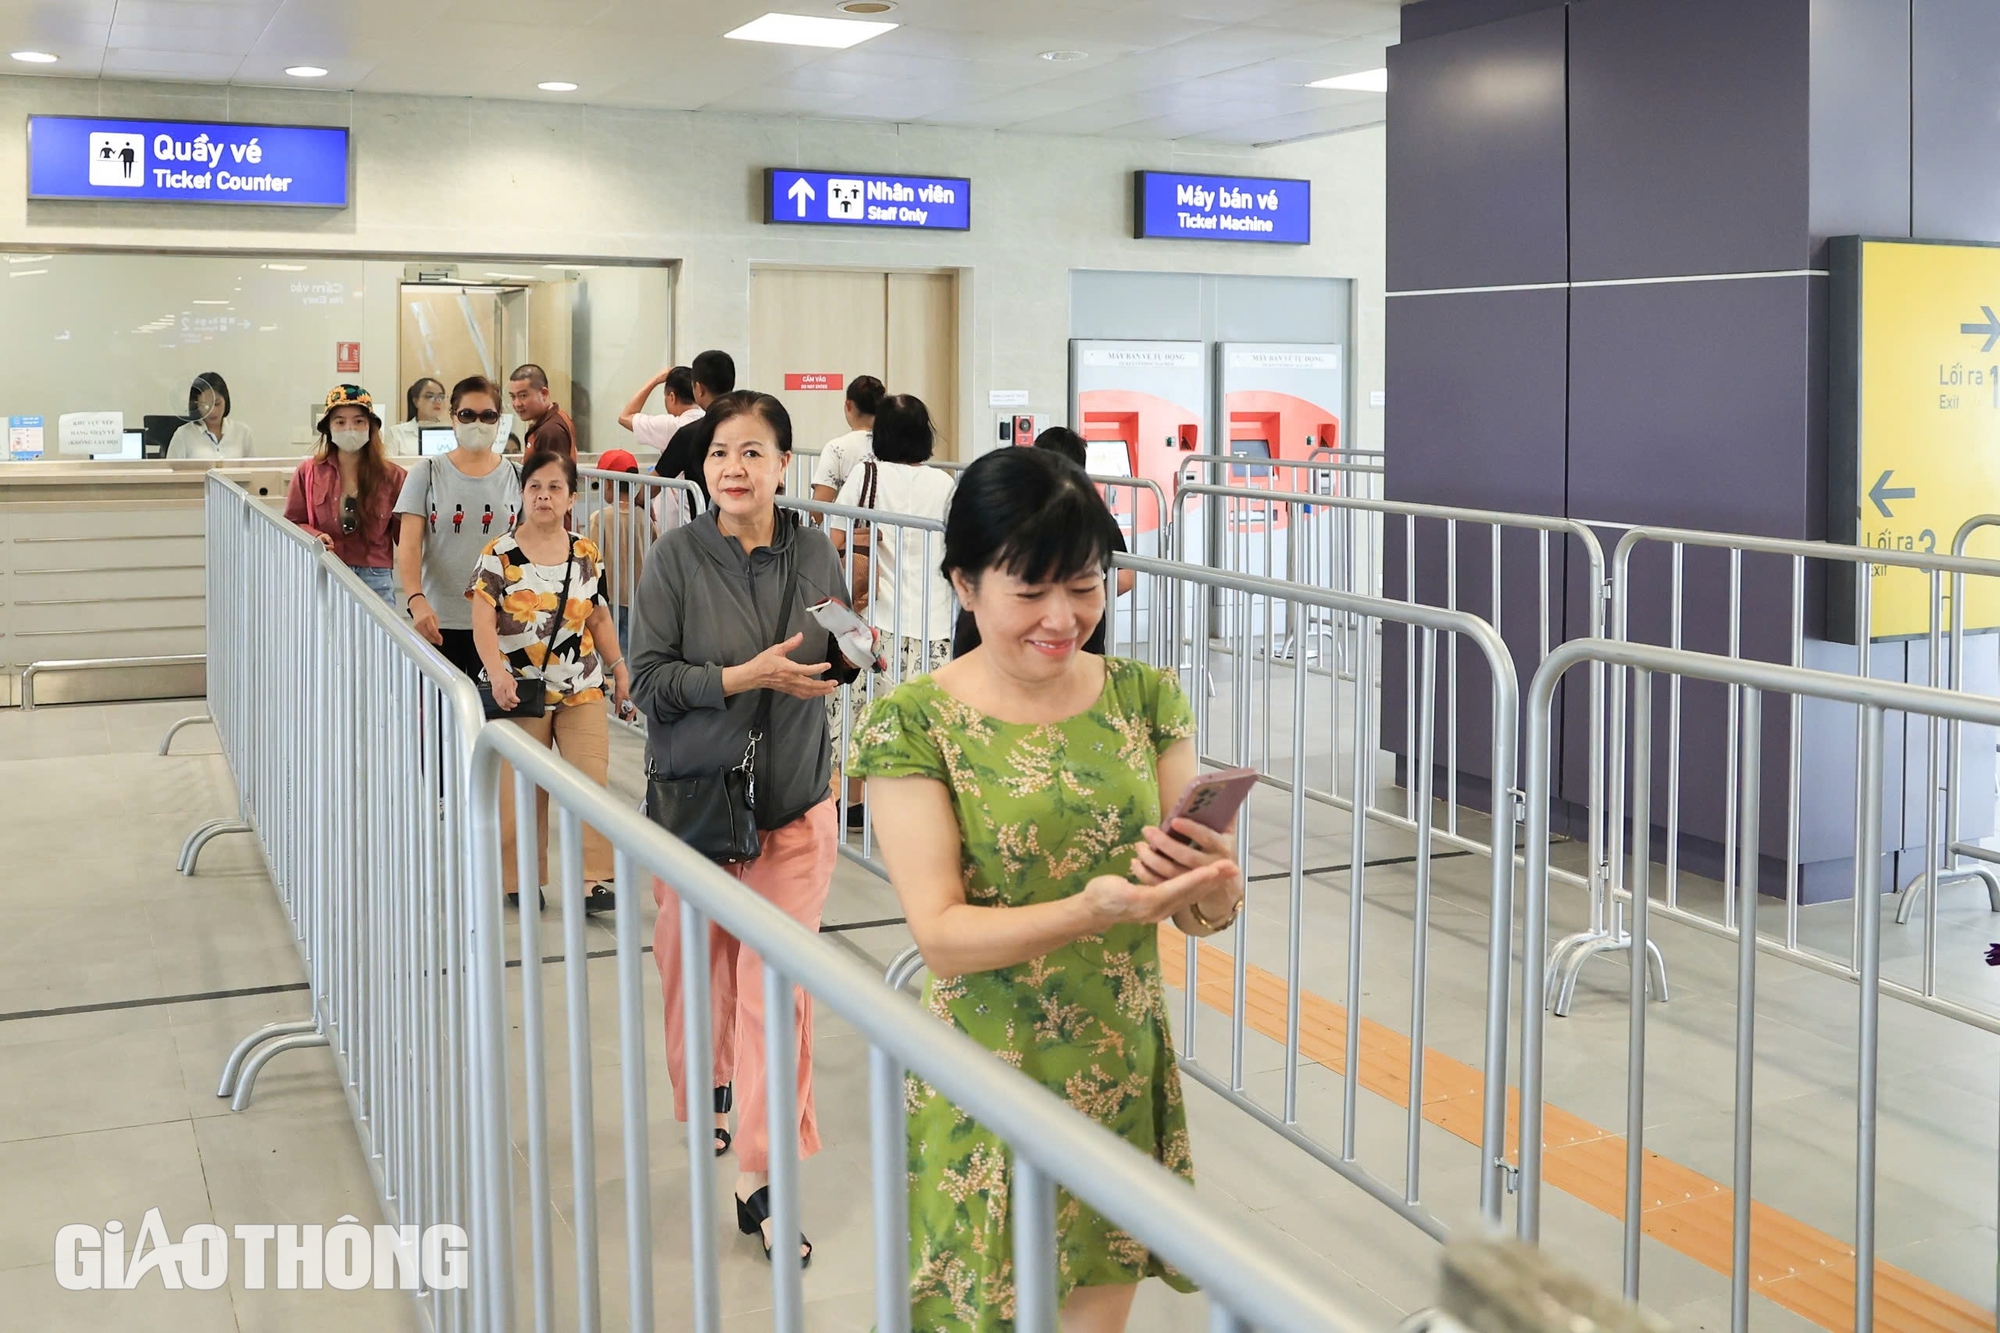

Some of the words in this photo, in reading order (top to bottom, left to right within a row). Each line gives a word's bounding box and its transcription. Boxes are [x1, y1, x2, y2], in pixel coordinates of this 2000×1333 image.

[153, 133, 225, 169] Quầy
[230, 138, 262, 164] vé
[152, 168, 213, 190] Ticket
[216, 170, 293, 192] Counter
[867, 180, 915, 202] Nhân
[917, 183, 955, 204] viên
[1177, 184, 1216, 213] Máy
[1219, 186, 1253, 210] bán
[1256, 189, 1279, 211] vé
[867, 205, 898, 221] Staff
[899, 207, 928, 226] Only
[1177, 212, 1218, 230] Ticket
[1220, 214, 1274, 232] Machine
[802, 375, 815, 383] CẤM
[815, 375, 827, 383] VÀO
[1939, 362, 1963, 386] Lối
[1968, 370, 1983, 385] ra
[1990, 365, 1998, 409] 1
[1940, 394, 1960, 409] Exit
[1897, 536, 1913, 551] ra
